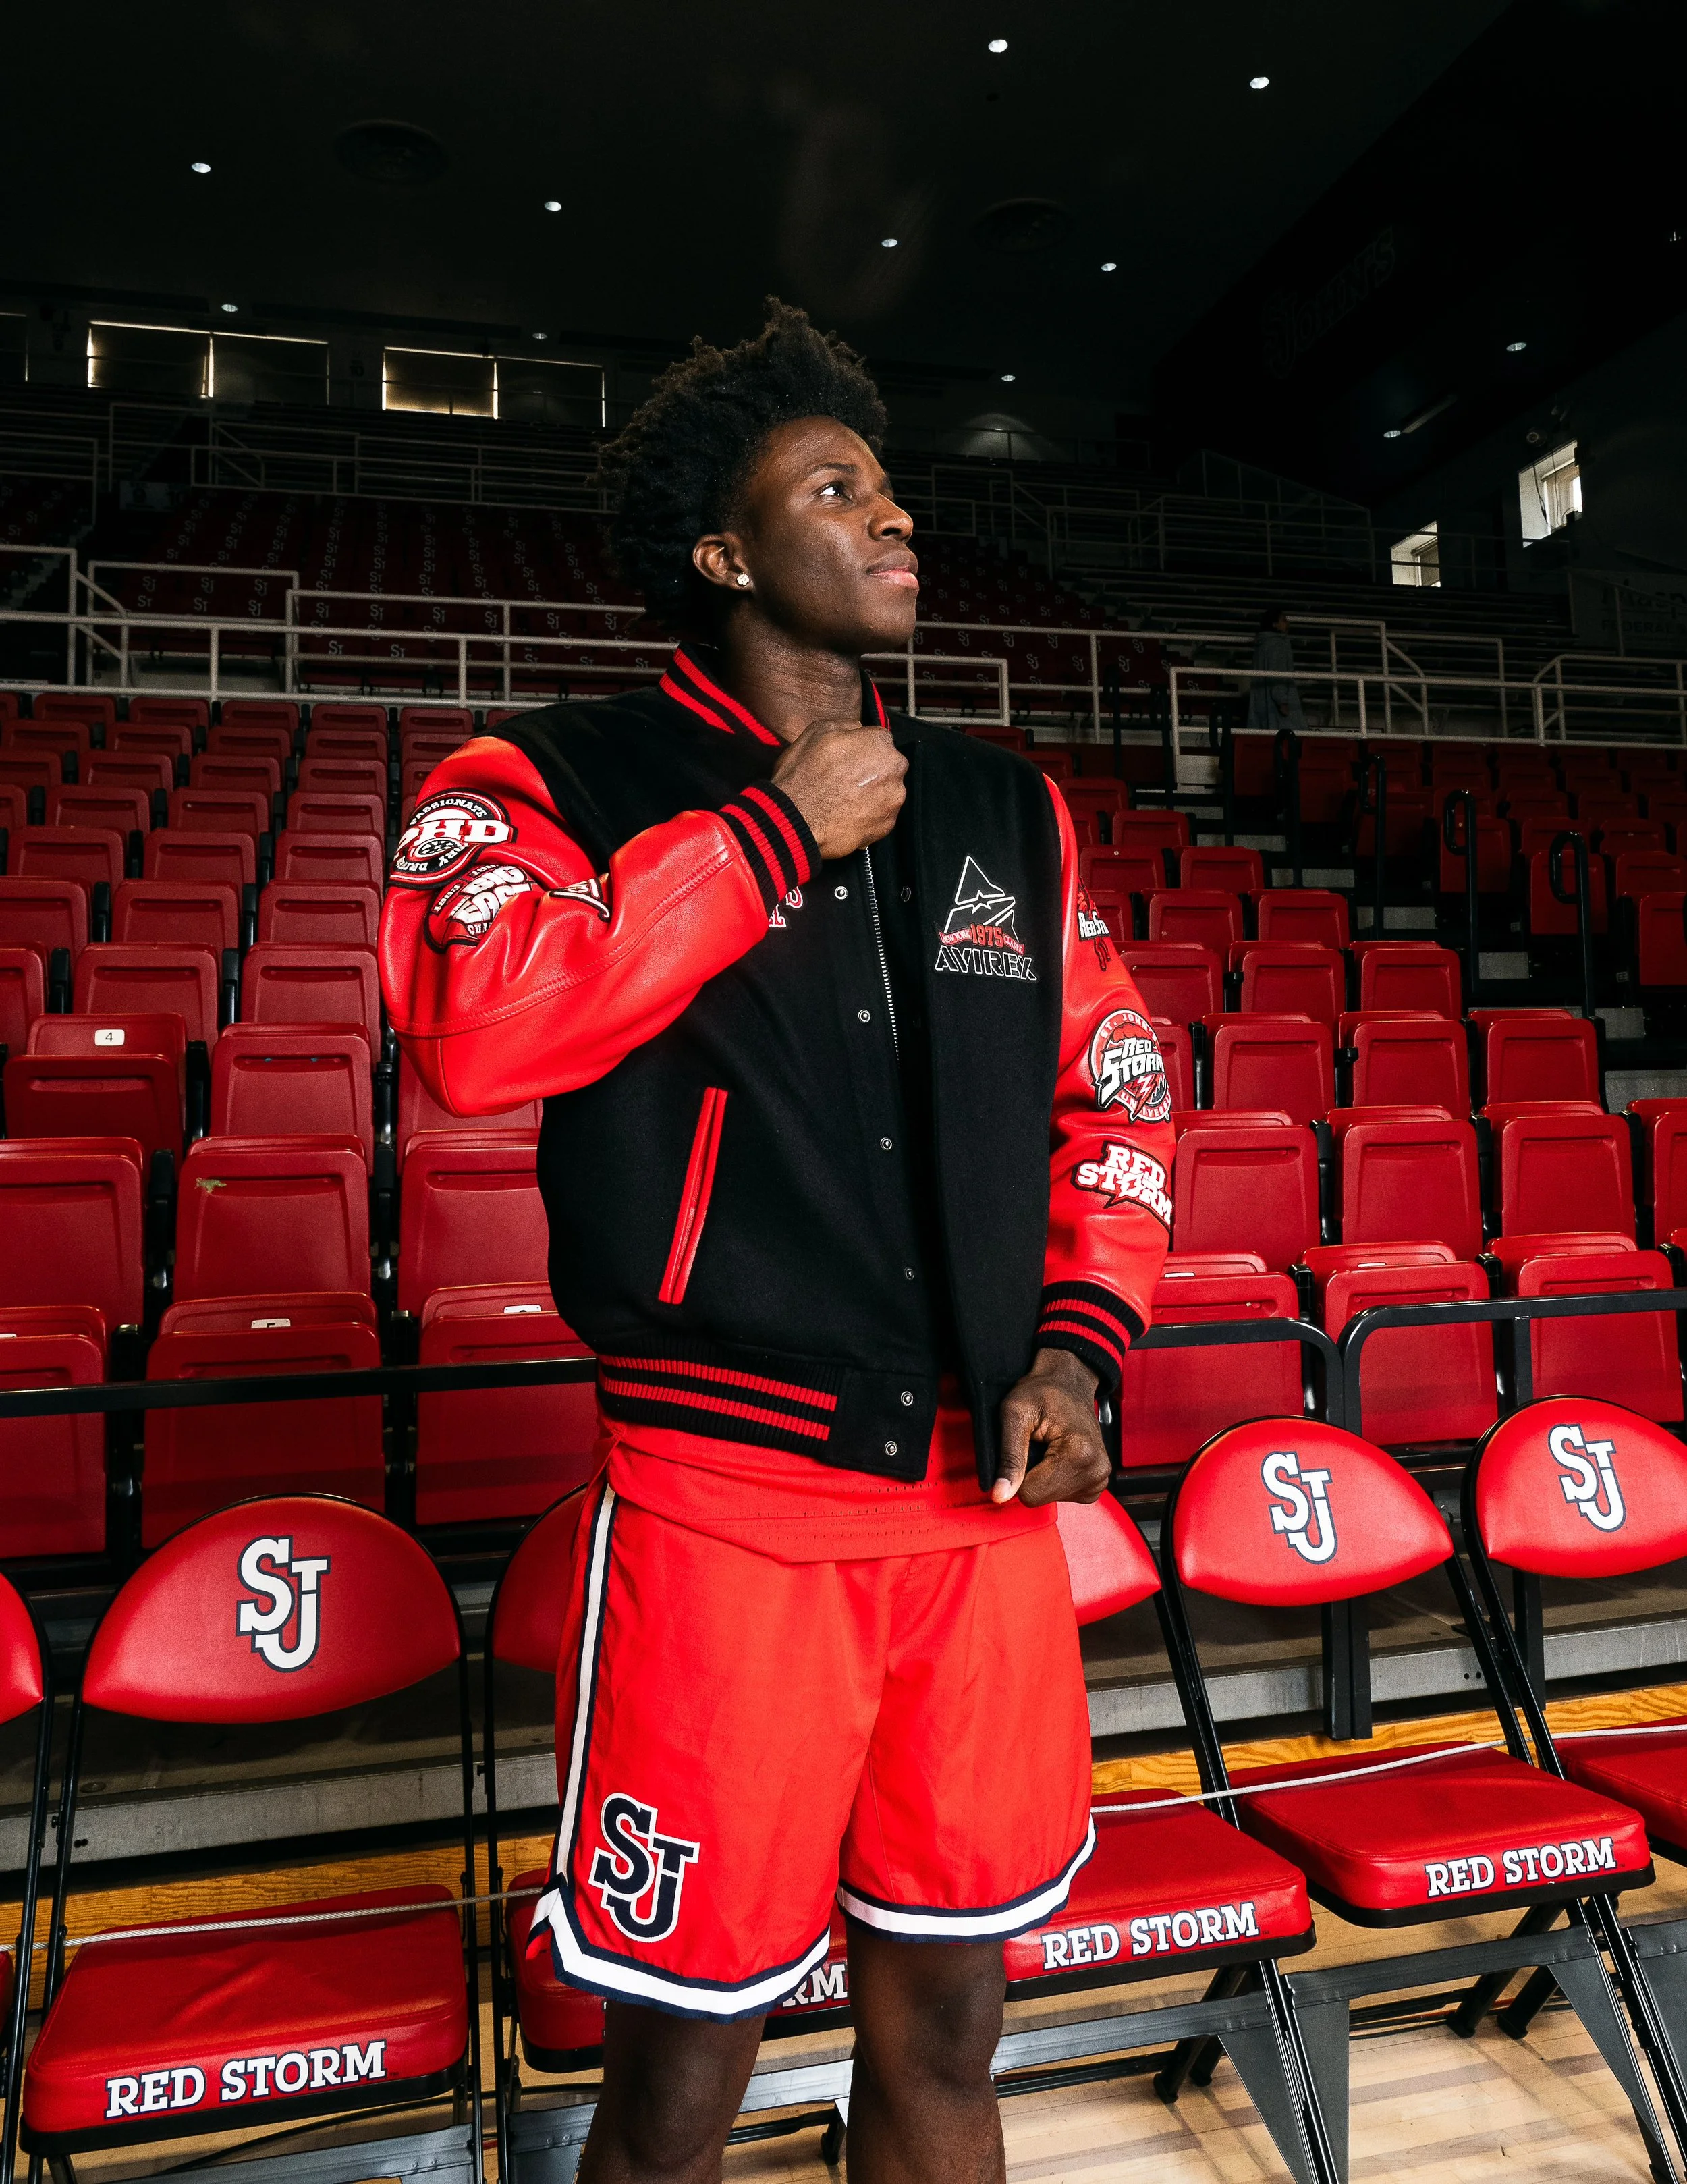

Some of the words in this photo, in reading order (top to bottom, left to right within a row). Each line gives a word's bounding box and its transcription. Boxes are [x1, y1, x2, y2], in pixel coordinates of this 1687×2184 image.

[410, 798, 487, 825] PASSIONATE
[970, 924, 1004, 947] 1975
[935, 945, 1037, 980] AVIREX
[105, 1032, 113, 1042] 4
[1122, 1037, 1152, 1059] RED
[1105, 1145, 1165, 1189] RED
[1078, 1163, 1173, 1225] STORM
[1425, 1855, 1495, 1898] RED
[1503, 1836, 1617, 1884] STORM
[1041, 1924, 1120, 1970] RED
[1130, 1902, 1259, 1956] STORM
[105, 2066, 207, 2119] RED
[219, 2040, 387, 2103] STORM
